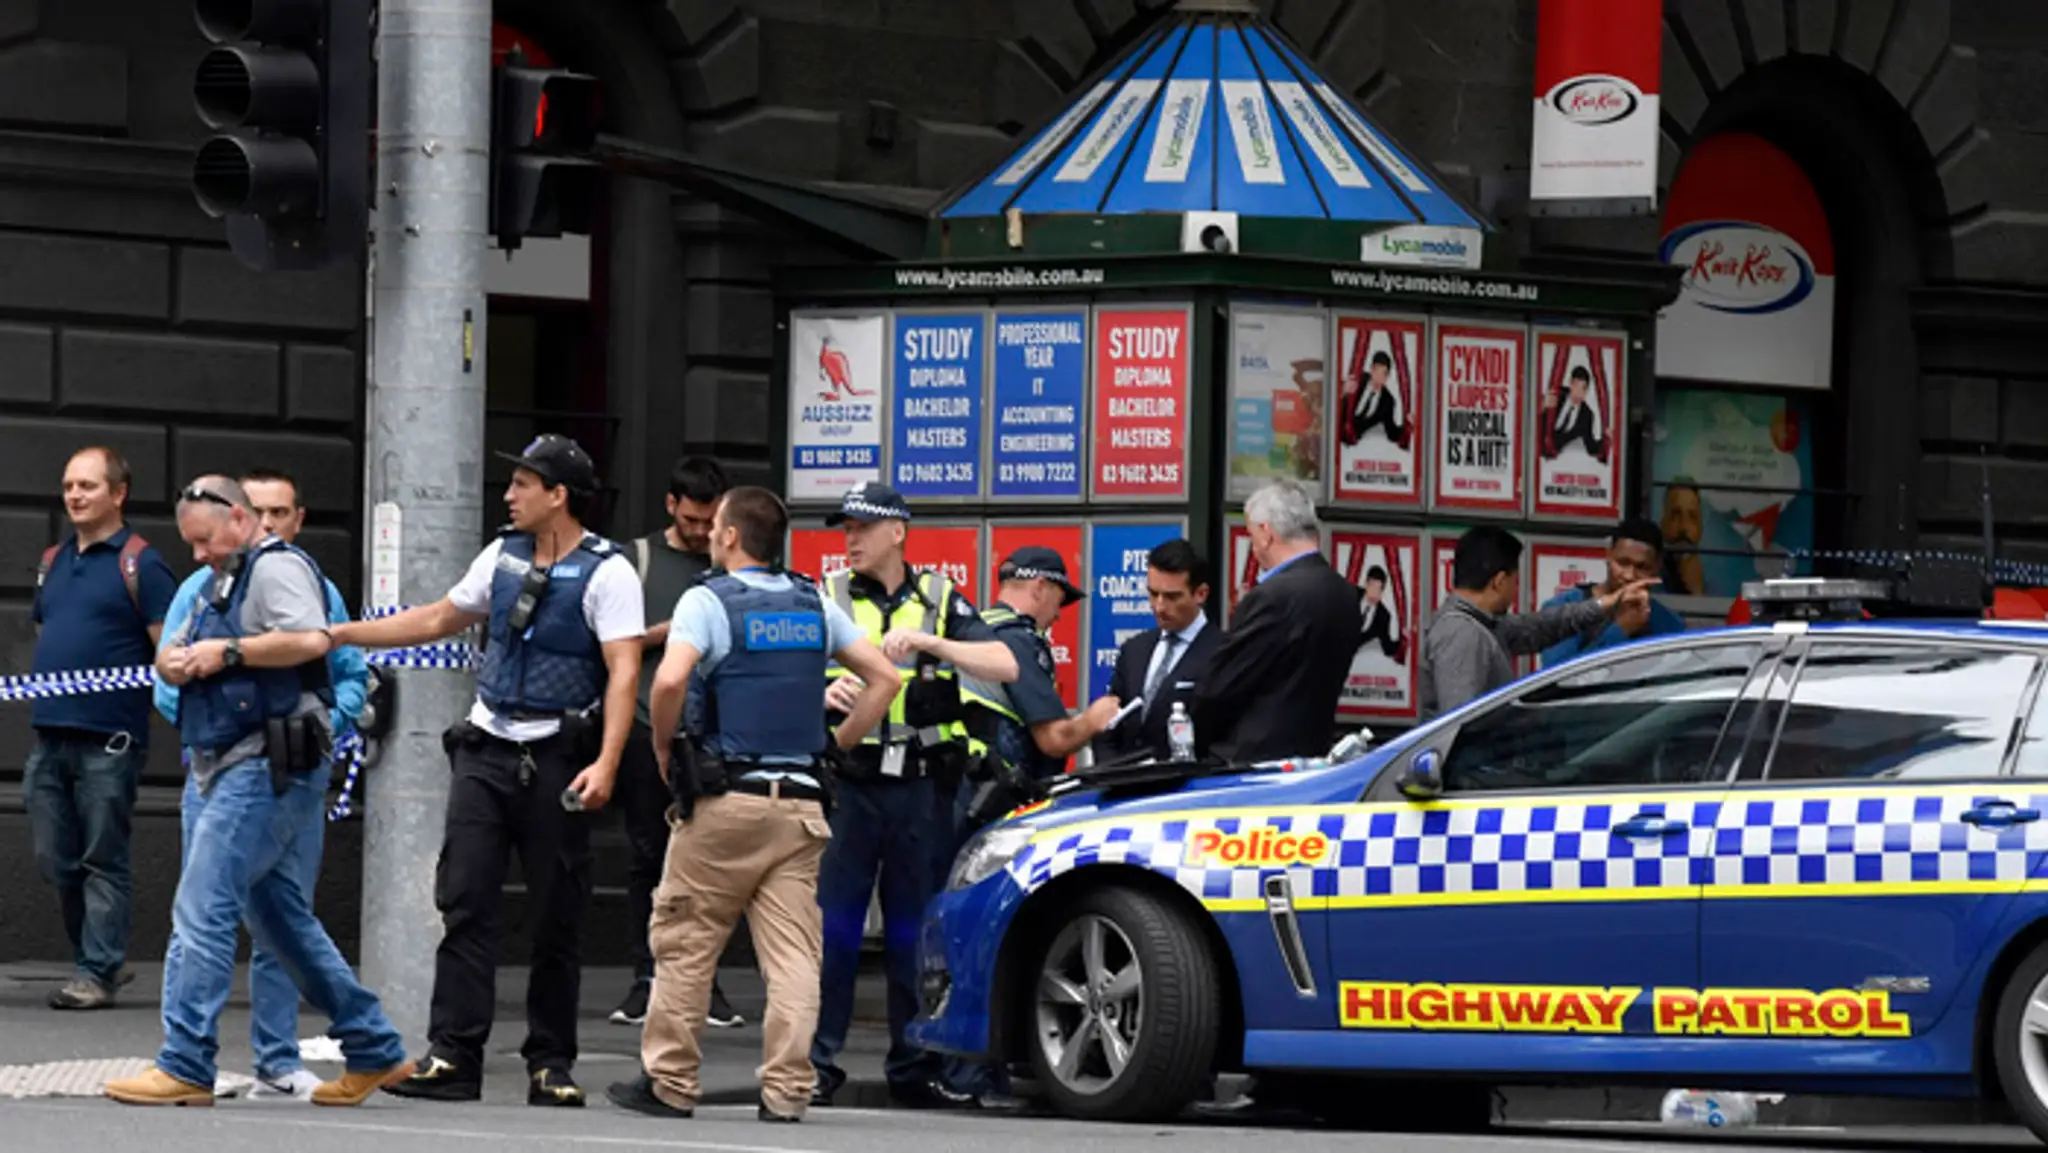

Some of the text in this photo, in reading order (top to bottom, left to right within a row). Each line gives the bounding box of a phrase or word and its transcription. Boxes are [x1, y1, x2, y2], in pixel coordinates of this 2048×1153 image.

[1383, 234, 1466, 257] Lycamobile
[895, 267, 1104, 289] www.lycamobile.com.au
[1331, 269, 1538, 299] www.lycamobile.com.au
[904, 328, 973, 361] STUDY
[999, 322, 1082, 346] PROFESSIONAL
[1109, 326, 1180, 360] STUDY
[1024, 347, 1054, 369] YEAR
[909, 367, 967, 388] DIPLOMA
[1032, 377, 1045, 396] IT
[1113, 366, 1172, 388] DIPLOMA
[802, 404, 873, 422] AUSSIZZ
[904, 397, 971, 418] BACHELOR
[1002, 405, 1075, 424] ACCOUNTING
[1108, 397, 1176, 418] BACHELOR
[1448, 410, 1507, 437] MUSICAL
[906, 427, 967, 448] MASTERS
[1000, 433, 1075, 452] ENGINEERING
[1111, 427, 1171, 449] MASTERS
[1464, 438, 1475, 467] A
[1122, 549, 1150, 573] PTE
[749, 618, 820, 644] Police
[1190, 829, 1325, 862] Police
[1345, 987, 1903, 1030] HIGHWAY PATROL
